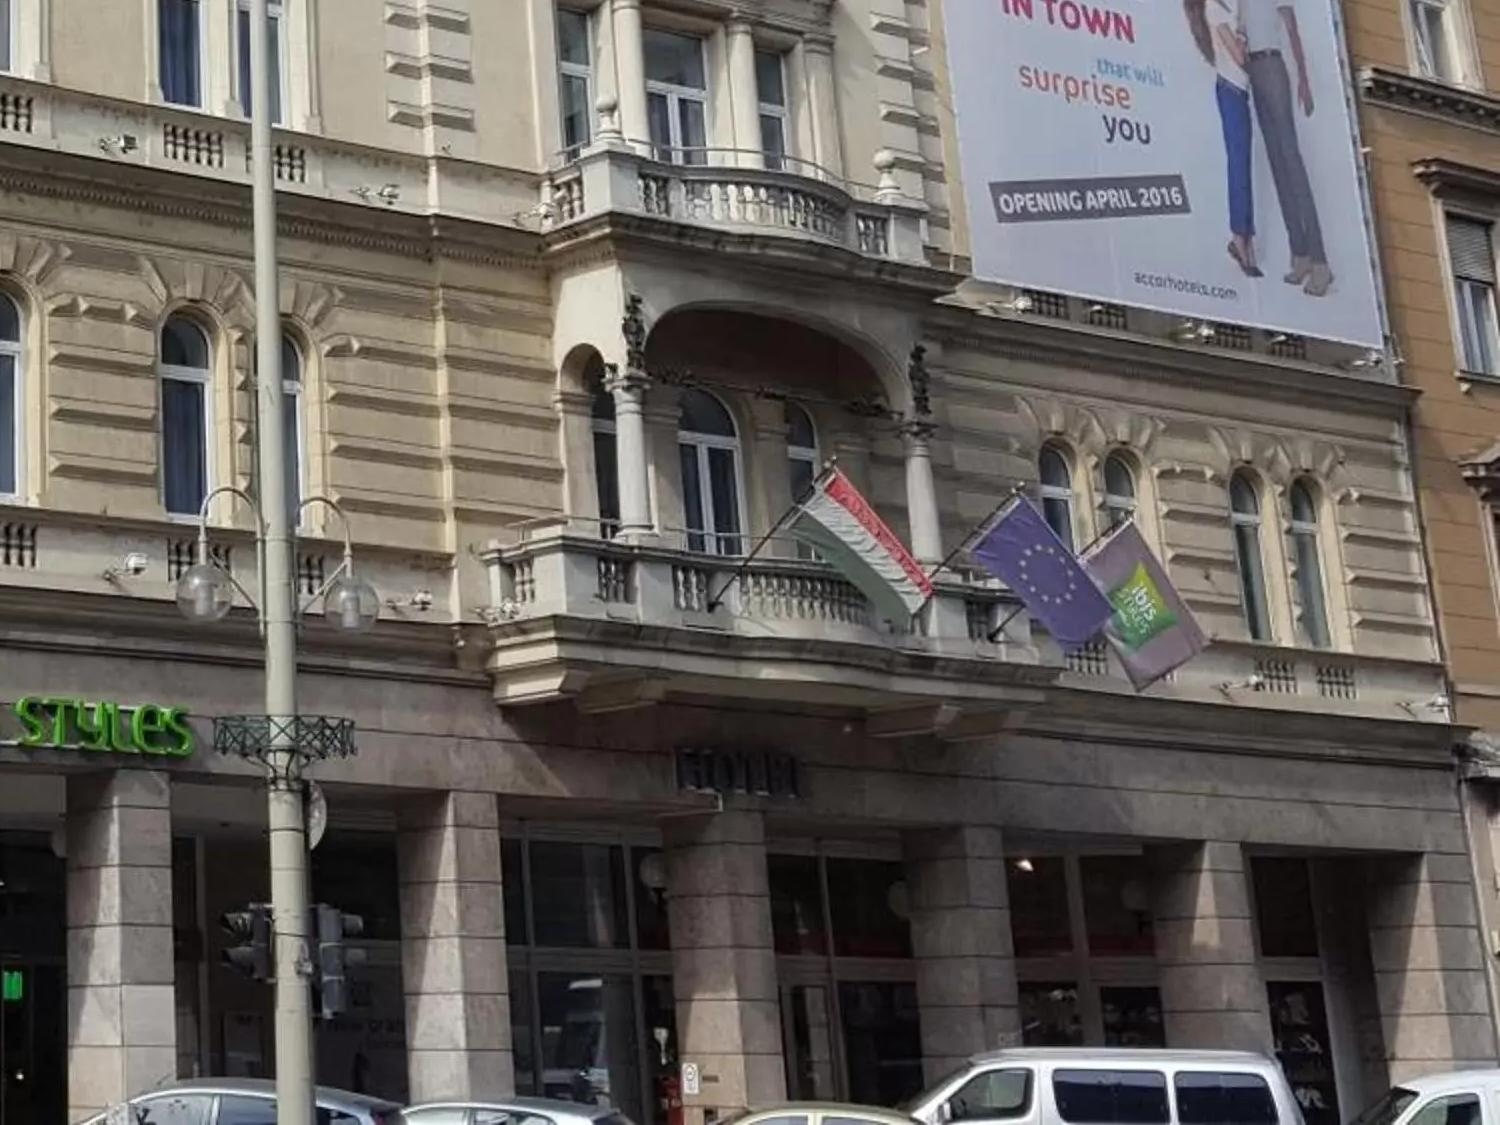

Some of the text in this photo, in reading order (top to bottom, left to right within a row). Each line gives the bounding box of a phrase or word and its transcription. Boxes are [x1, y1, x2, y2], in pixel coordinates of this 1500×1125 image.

[1018, 64, 1132, 110] surprise
[1097, 58, 1165, 87] that will
[1102, 114, 1151, 145] you
[999, 186, 1183, 215] OPENING APRIL 2016
[1133, 271, 1238, 299] accorhotels.com
